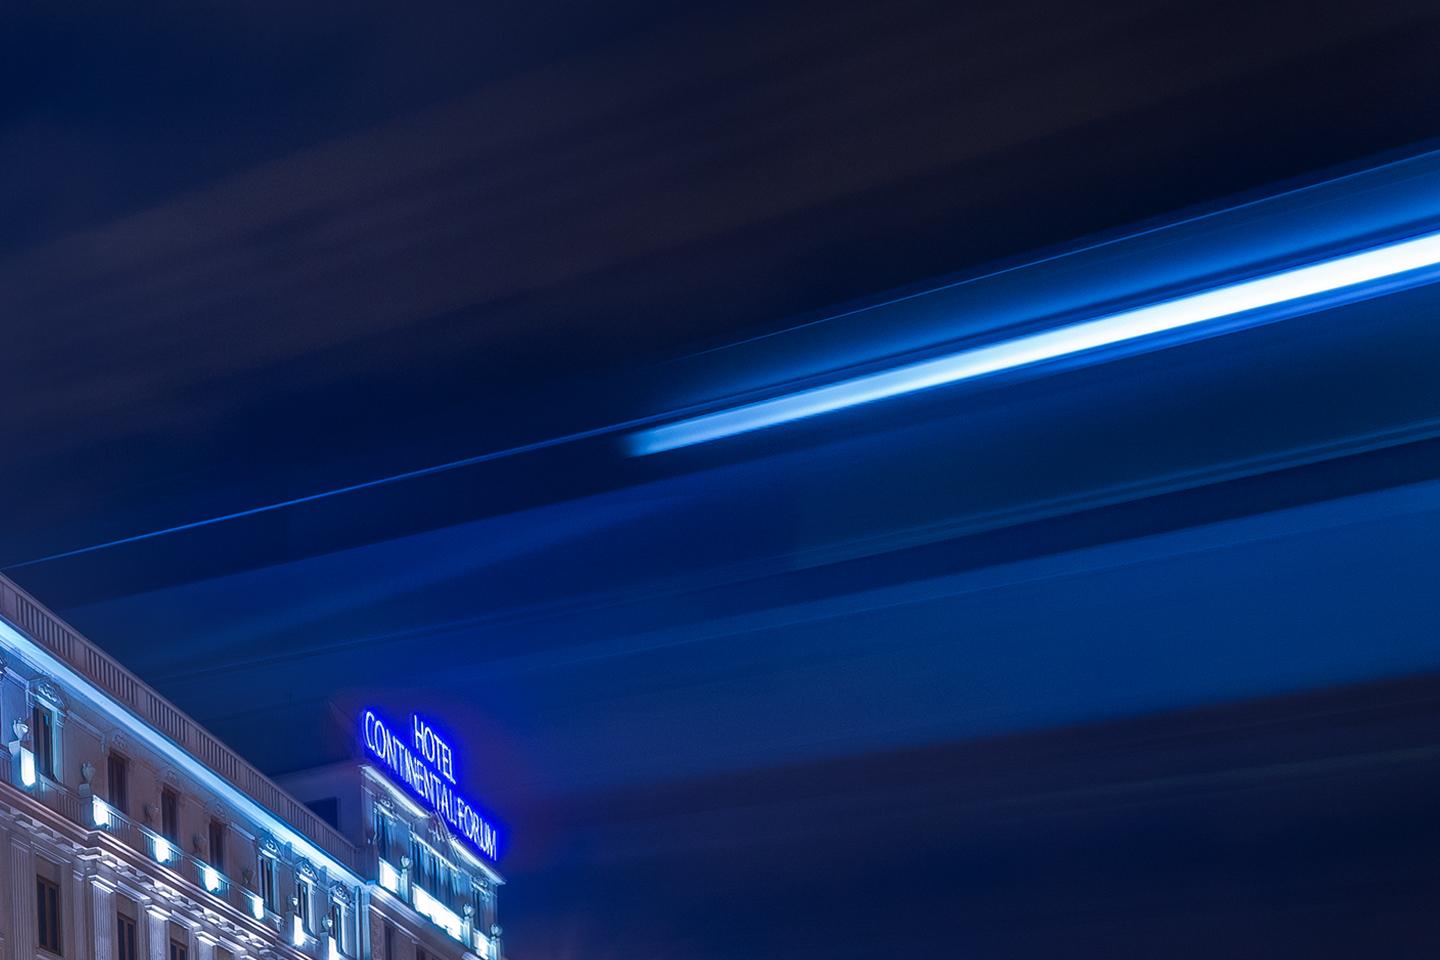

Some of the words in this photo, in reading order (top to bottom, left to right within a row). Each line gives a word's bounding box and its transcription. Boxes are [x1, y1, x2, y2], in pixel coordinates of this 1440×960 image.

[365, 711, 456, 826] CONTINENTAL
[457, 797, 497, 861] FORUM
[413, 714, 456, 784] HOTEL
